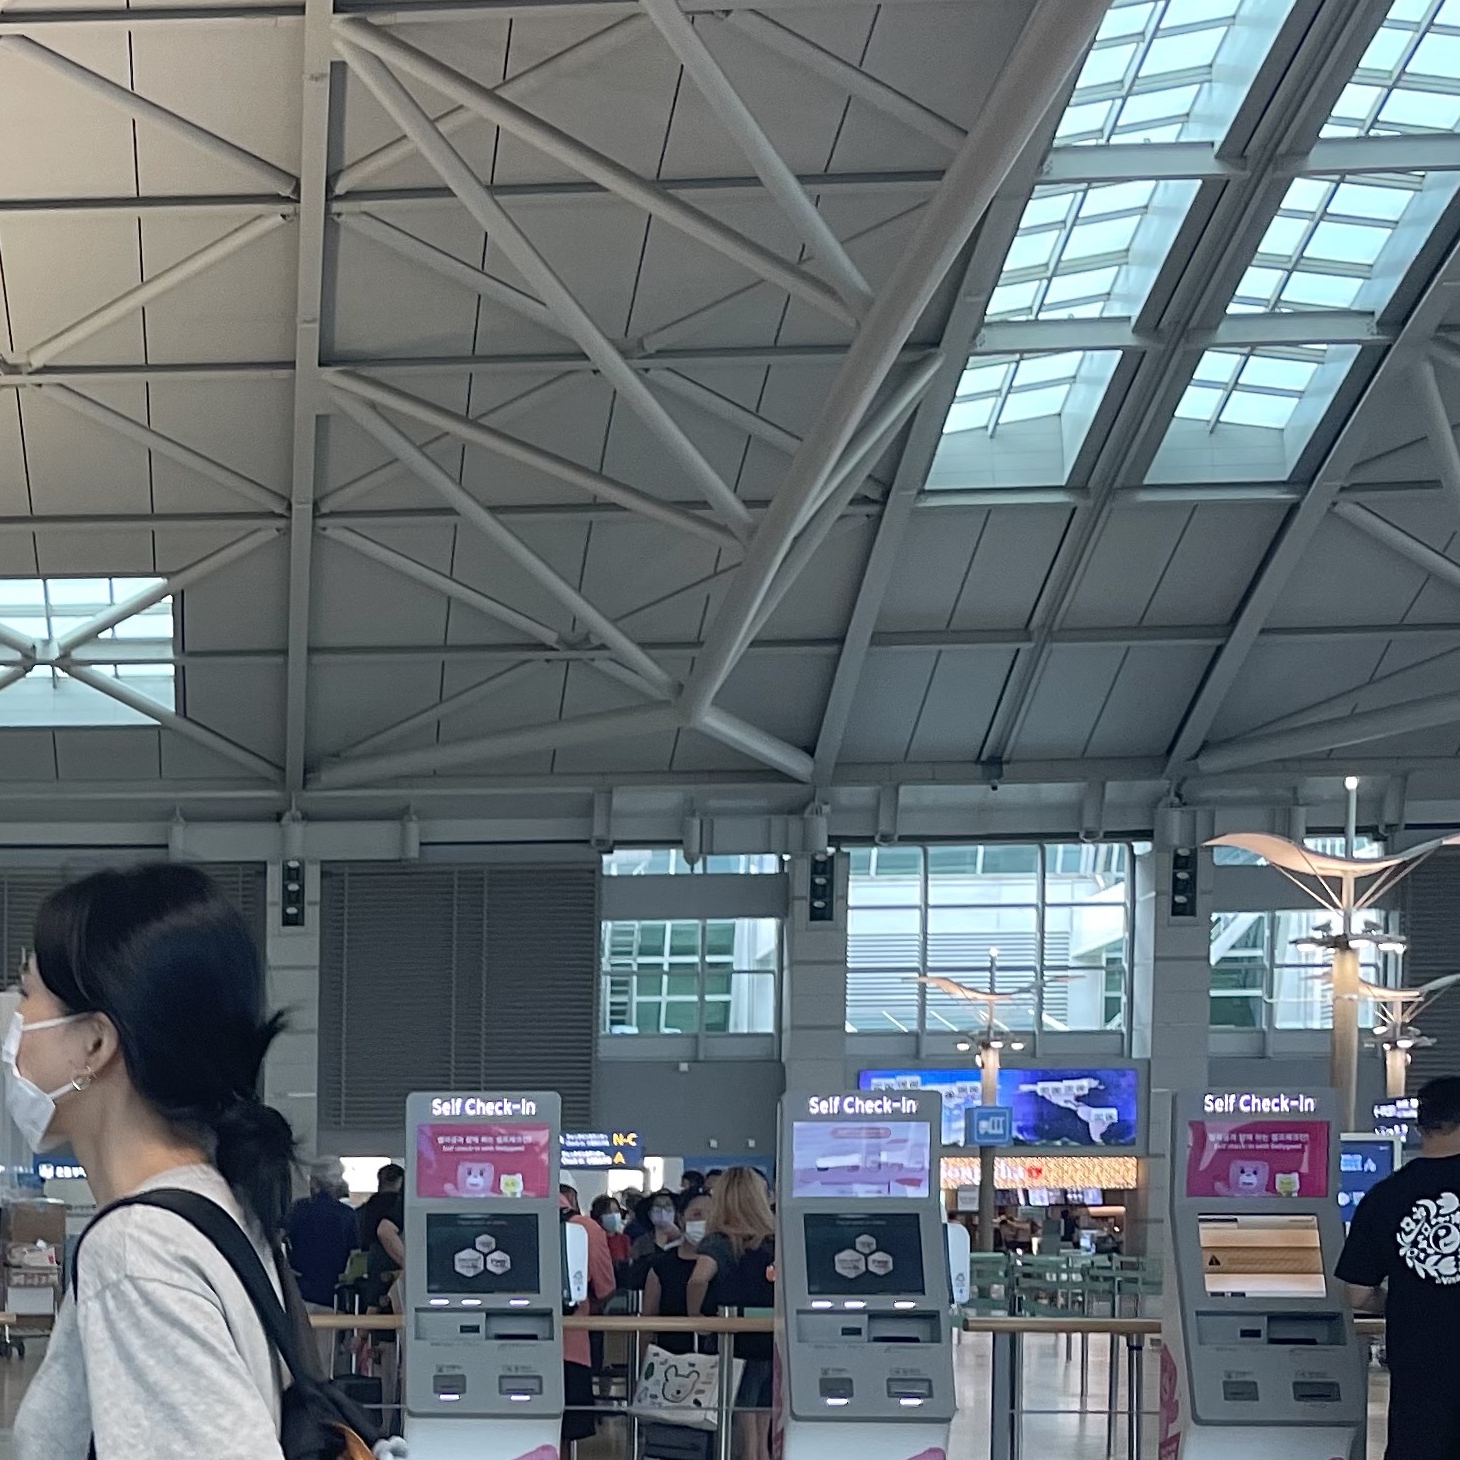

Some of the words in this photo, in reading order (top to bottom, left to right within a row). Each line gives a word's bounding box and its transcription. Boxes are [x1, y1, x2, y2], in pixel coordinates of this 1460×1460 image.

[432, 1098, 461, 1116] Self
[465, 1097, 536, 1116] Check-In
[809, 1096, 840, 1114] Self
[843, 1096, 917, 1114] Check-In
[1204, 1094, 1236, 1112] Self
[1240, 1094, 1315, 1112] Check-In
